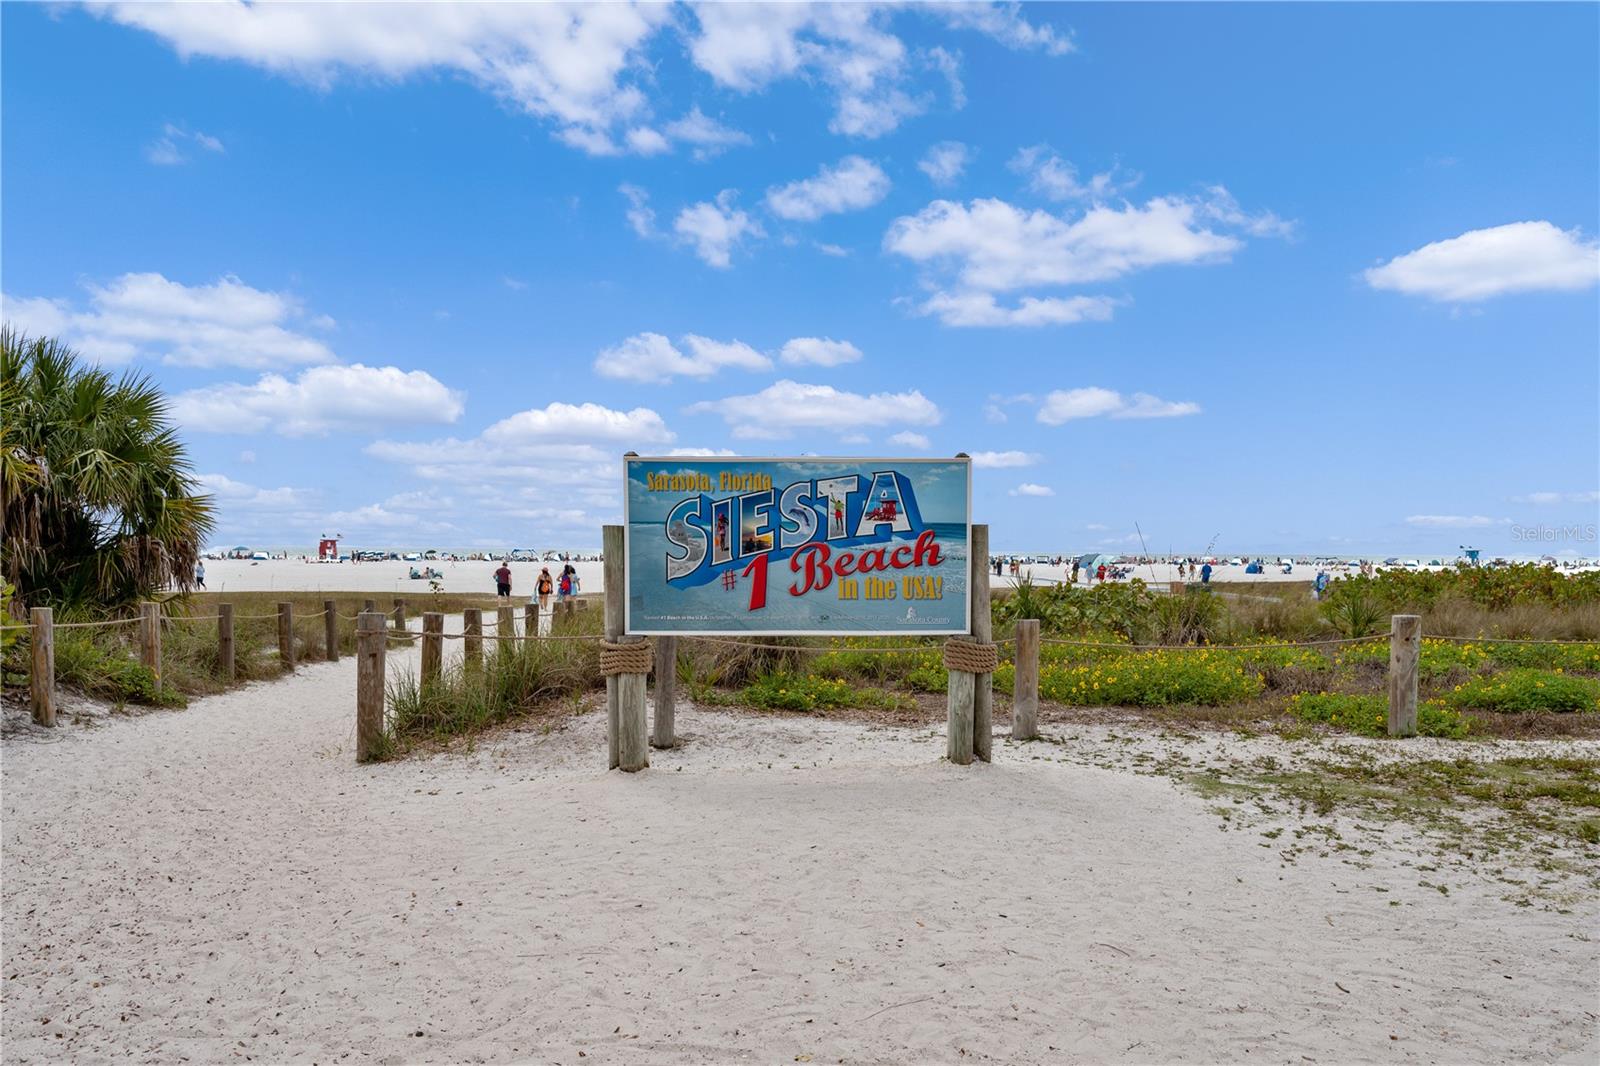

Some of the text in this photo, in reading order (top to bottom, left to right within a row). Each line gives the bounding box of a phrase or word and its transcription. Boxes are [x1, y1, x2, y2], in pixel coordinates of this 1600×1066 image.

[647, 471, 772, 493] Sarasota, Florida
[666, 470, 914, 583] SIESTA
[788, 529, 945, 597] Beach
[838, 575, 943, 600] in the USA!
